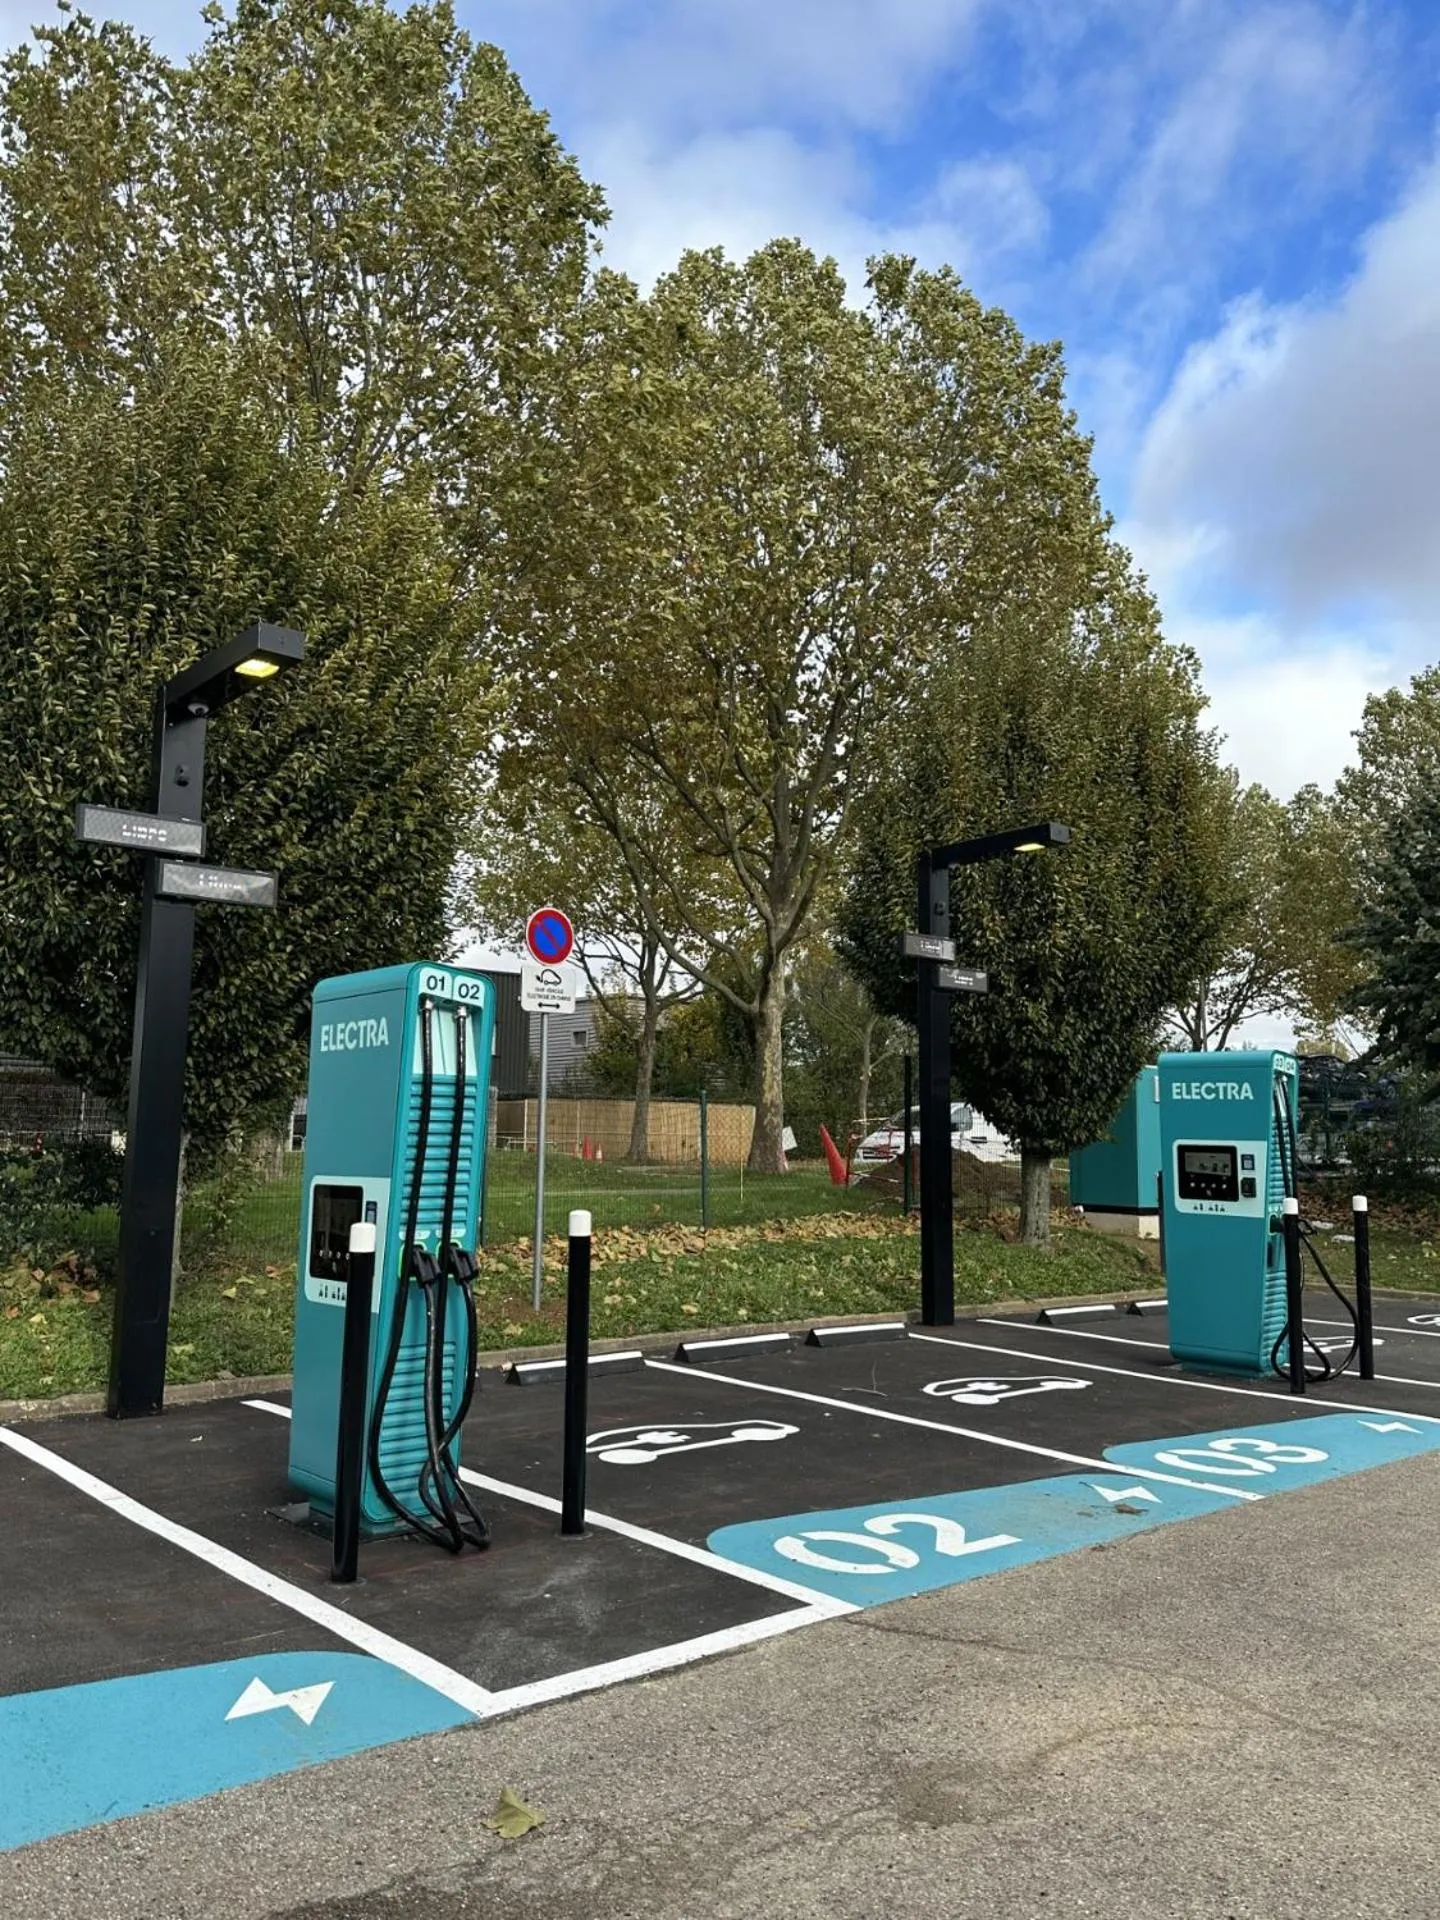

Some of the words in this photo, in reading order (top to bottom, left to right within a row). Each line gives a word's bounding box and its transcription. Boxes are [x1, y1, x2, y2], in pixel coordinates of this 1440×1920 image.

[426, 975, 446, 991] 01
[457, 983, 480, 999] 02
[320, 1017, 389, 1052] ELECTRA
[1172, 1082, 1254, 1101] ELECTRA
[1154, 1438, 1329, 1477] 03
[773, 1513, 1022, 1574] 02
